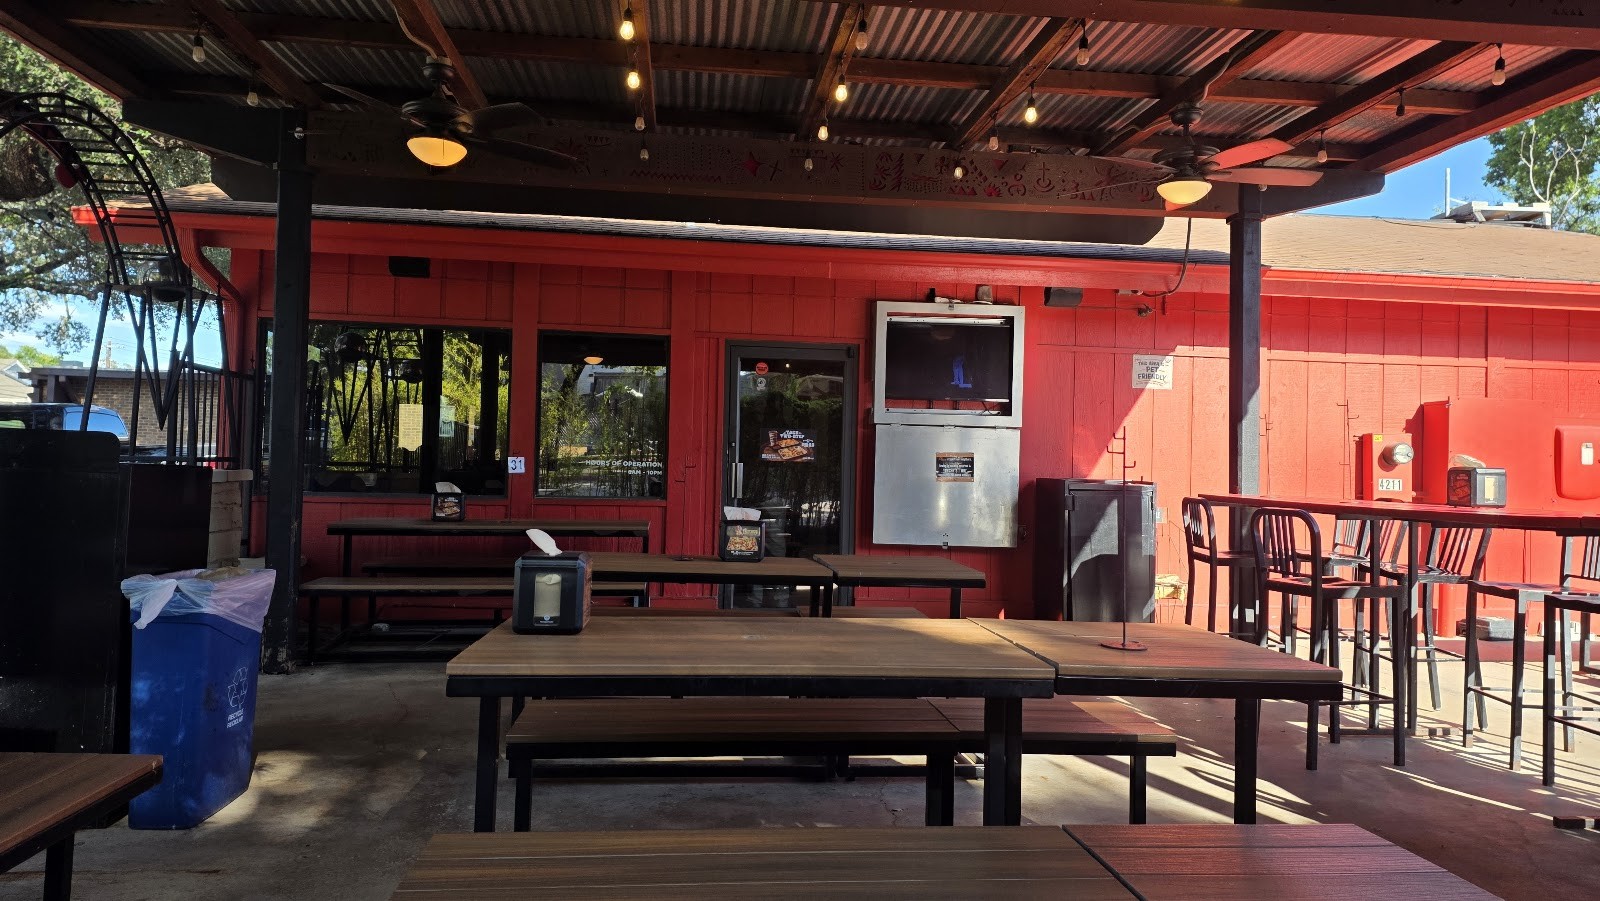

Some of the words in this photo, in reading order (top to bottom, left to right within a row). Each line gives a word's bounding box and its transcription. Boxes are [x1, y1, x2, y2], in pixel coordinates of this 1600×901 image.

[1137, 373, 1167, 381] FRIENDLY
[510, 459, 523, 471] 31
[1379, 479, 1401, 491] 4211
